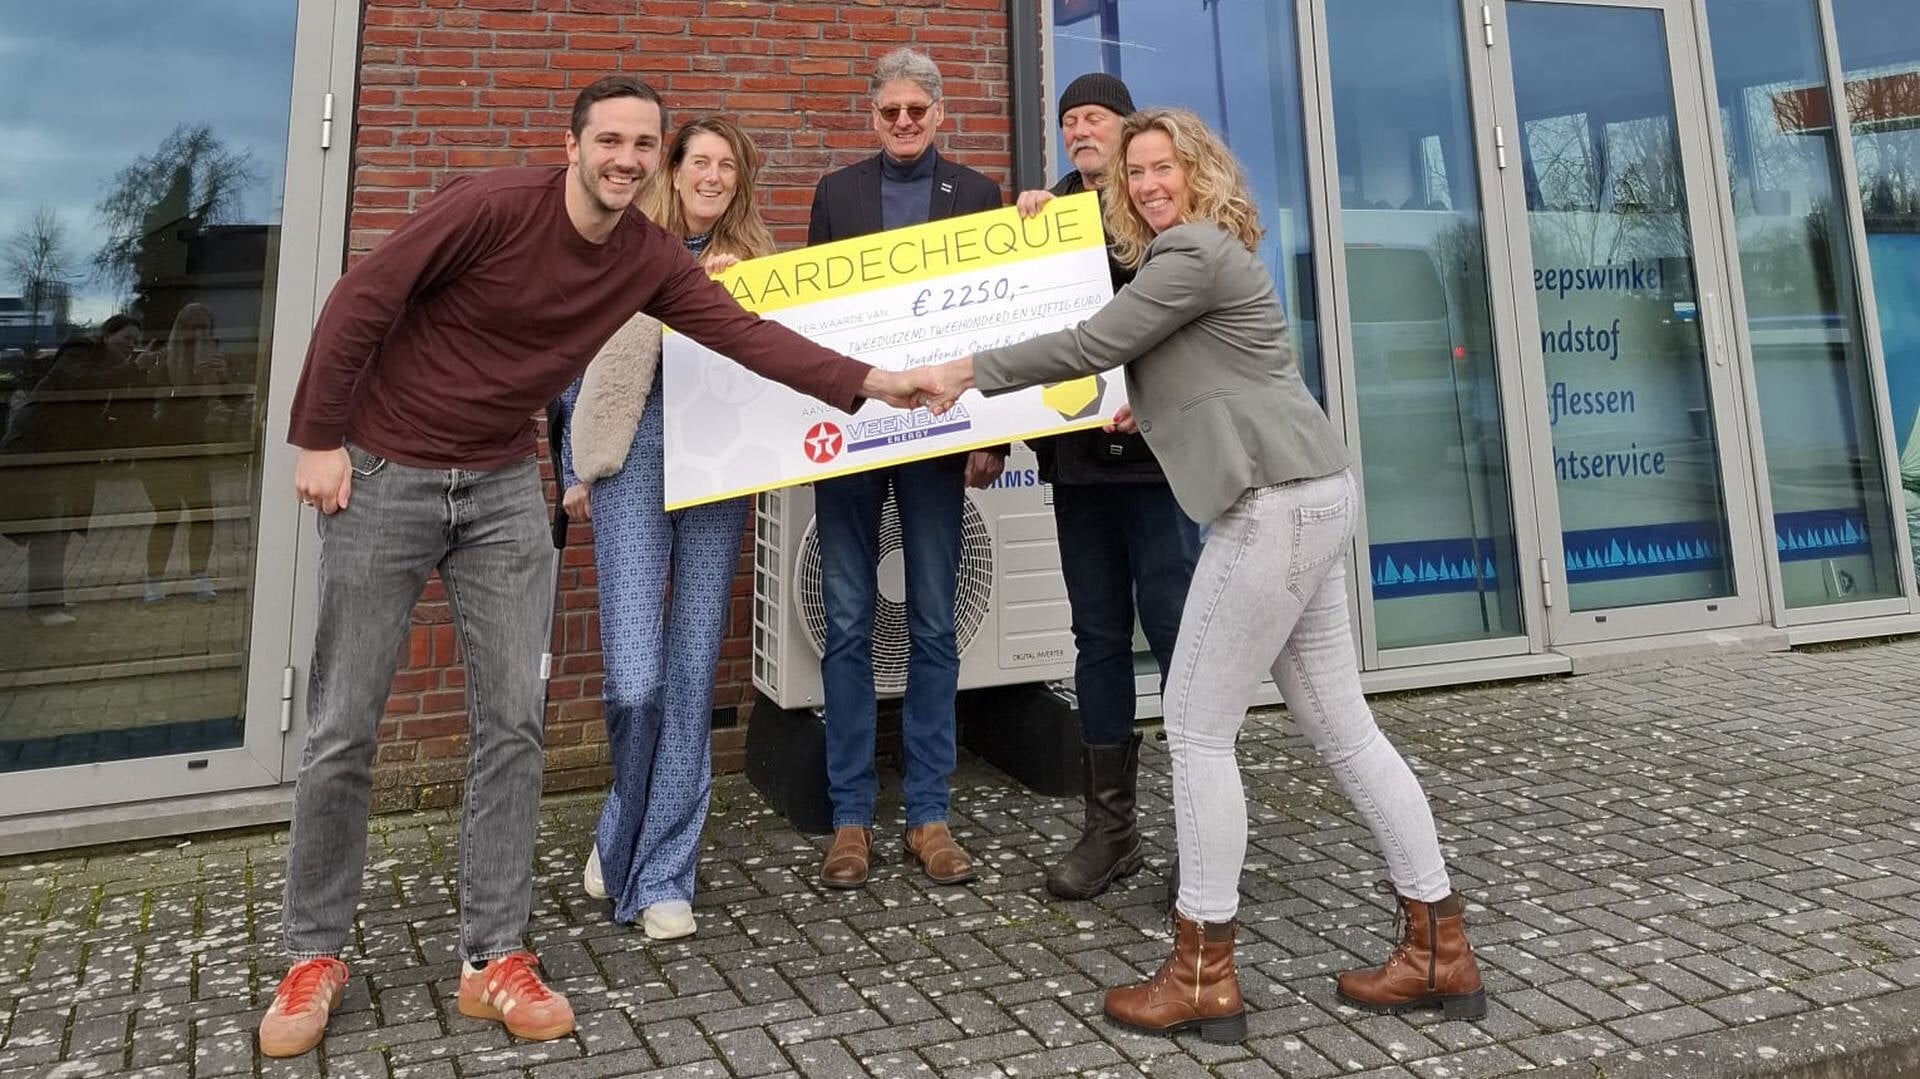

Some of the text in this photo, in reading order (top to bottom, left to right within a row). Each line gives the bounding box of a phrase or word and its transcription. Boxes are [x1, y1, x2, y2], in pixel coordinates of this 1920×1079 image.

[722, 209, 1082, 305] AARDECHEQUE
[1534, 258, 1664, 299] eepswinkel
[820, 313, 864, 331] WAARDE
[866, 309, 889, 321] VAN
[911, 288, 931, 317] €
[849, 328, 926, 353] TWEEDUIZEND
[930, 311, 1010, 336] TWEEHONDERD
[1012, 308, 1028, 320] EN
[1073, 294, 1102, 308] EURO
[1541, 319, 1620, 361] ndstof
[1548, 382, 1635, 425] flessen
[887, 430, 929, 444] ENERGY
[991, 469, 1044, 489] AMS
[1552, 442, 1666, 480] htservice
